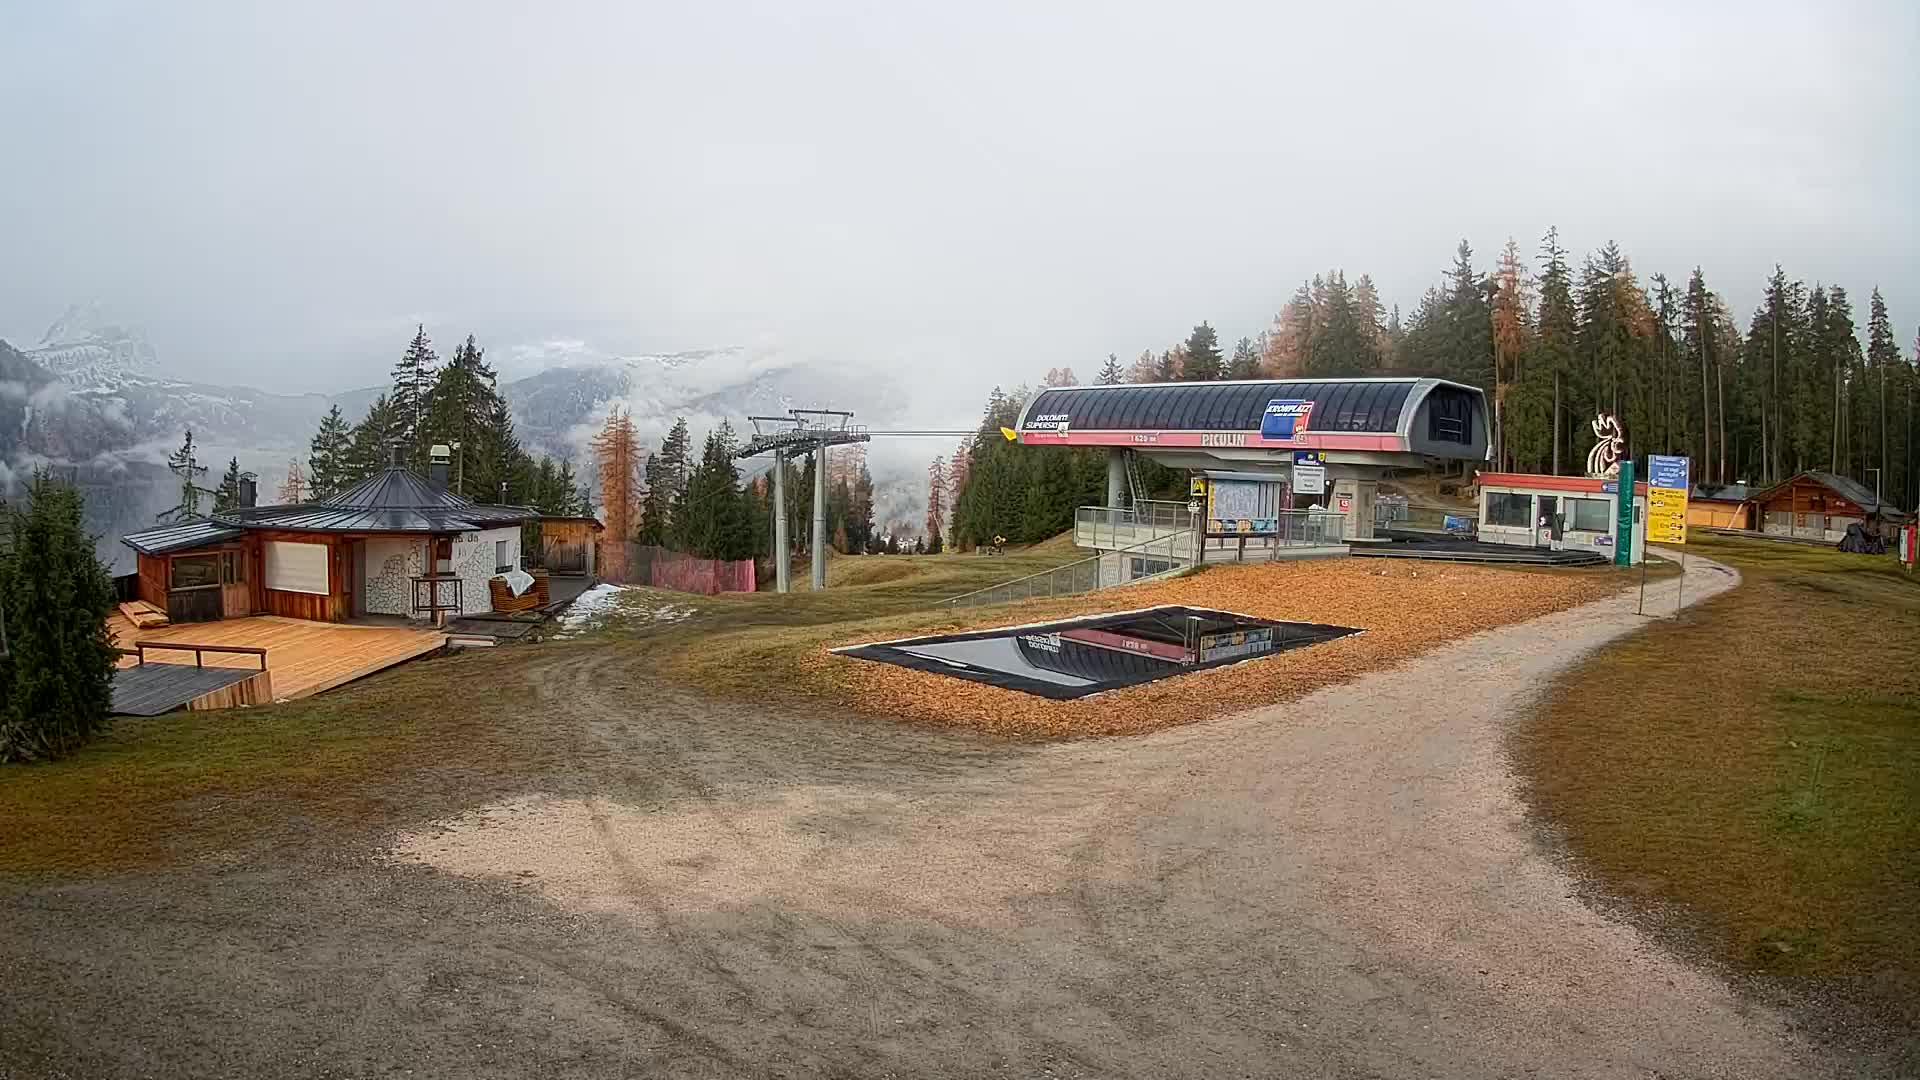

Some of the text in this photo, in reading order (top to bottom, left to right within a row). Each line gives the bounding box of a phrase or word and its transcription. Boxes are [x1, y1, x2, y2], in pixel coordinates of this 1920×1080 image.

[1266, 404, 1313, 413] KRONPLATZ
[1036, 414, 1069, 422] DOLOMITI
[1025, 421, 1058, 429] SUPERSKI
[1201, 433, 1246, 447] PICULIN
